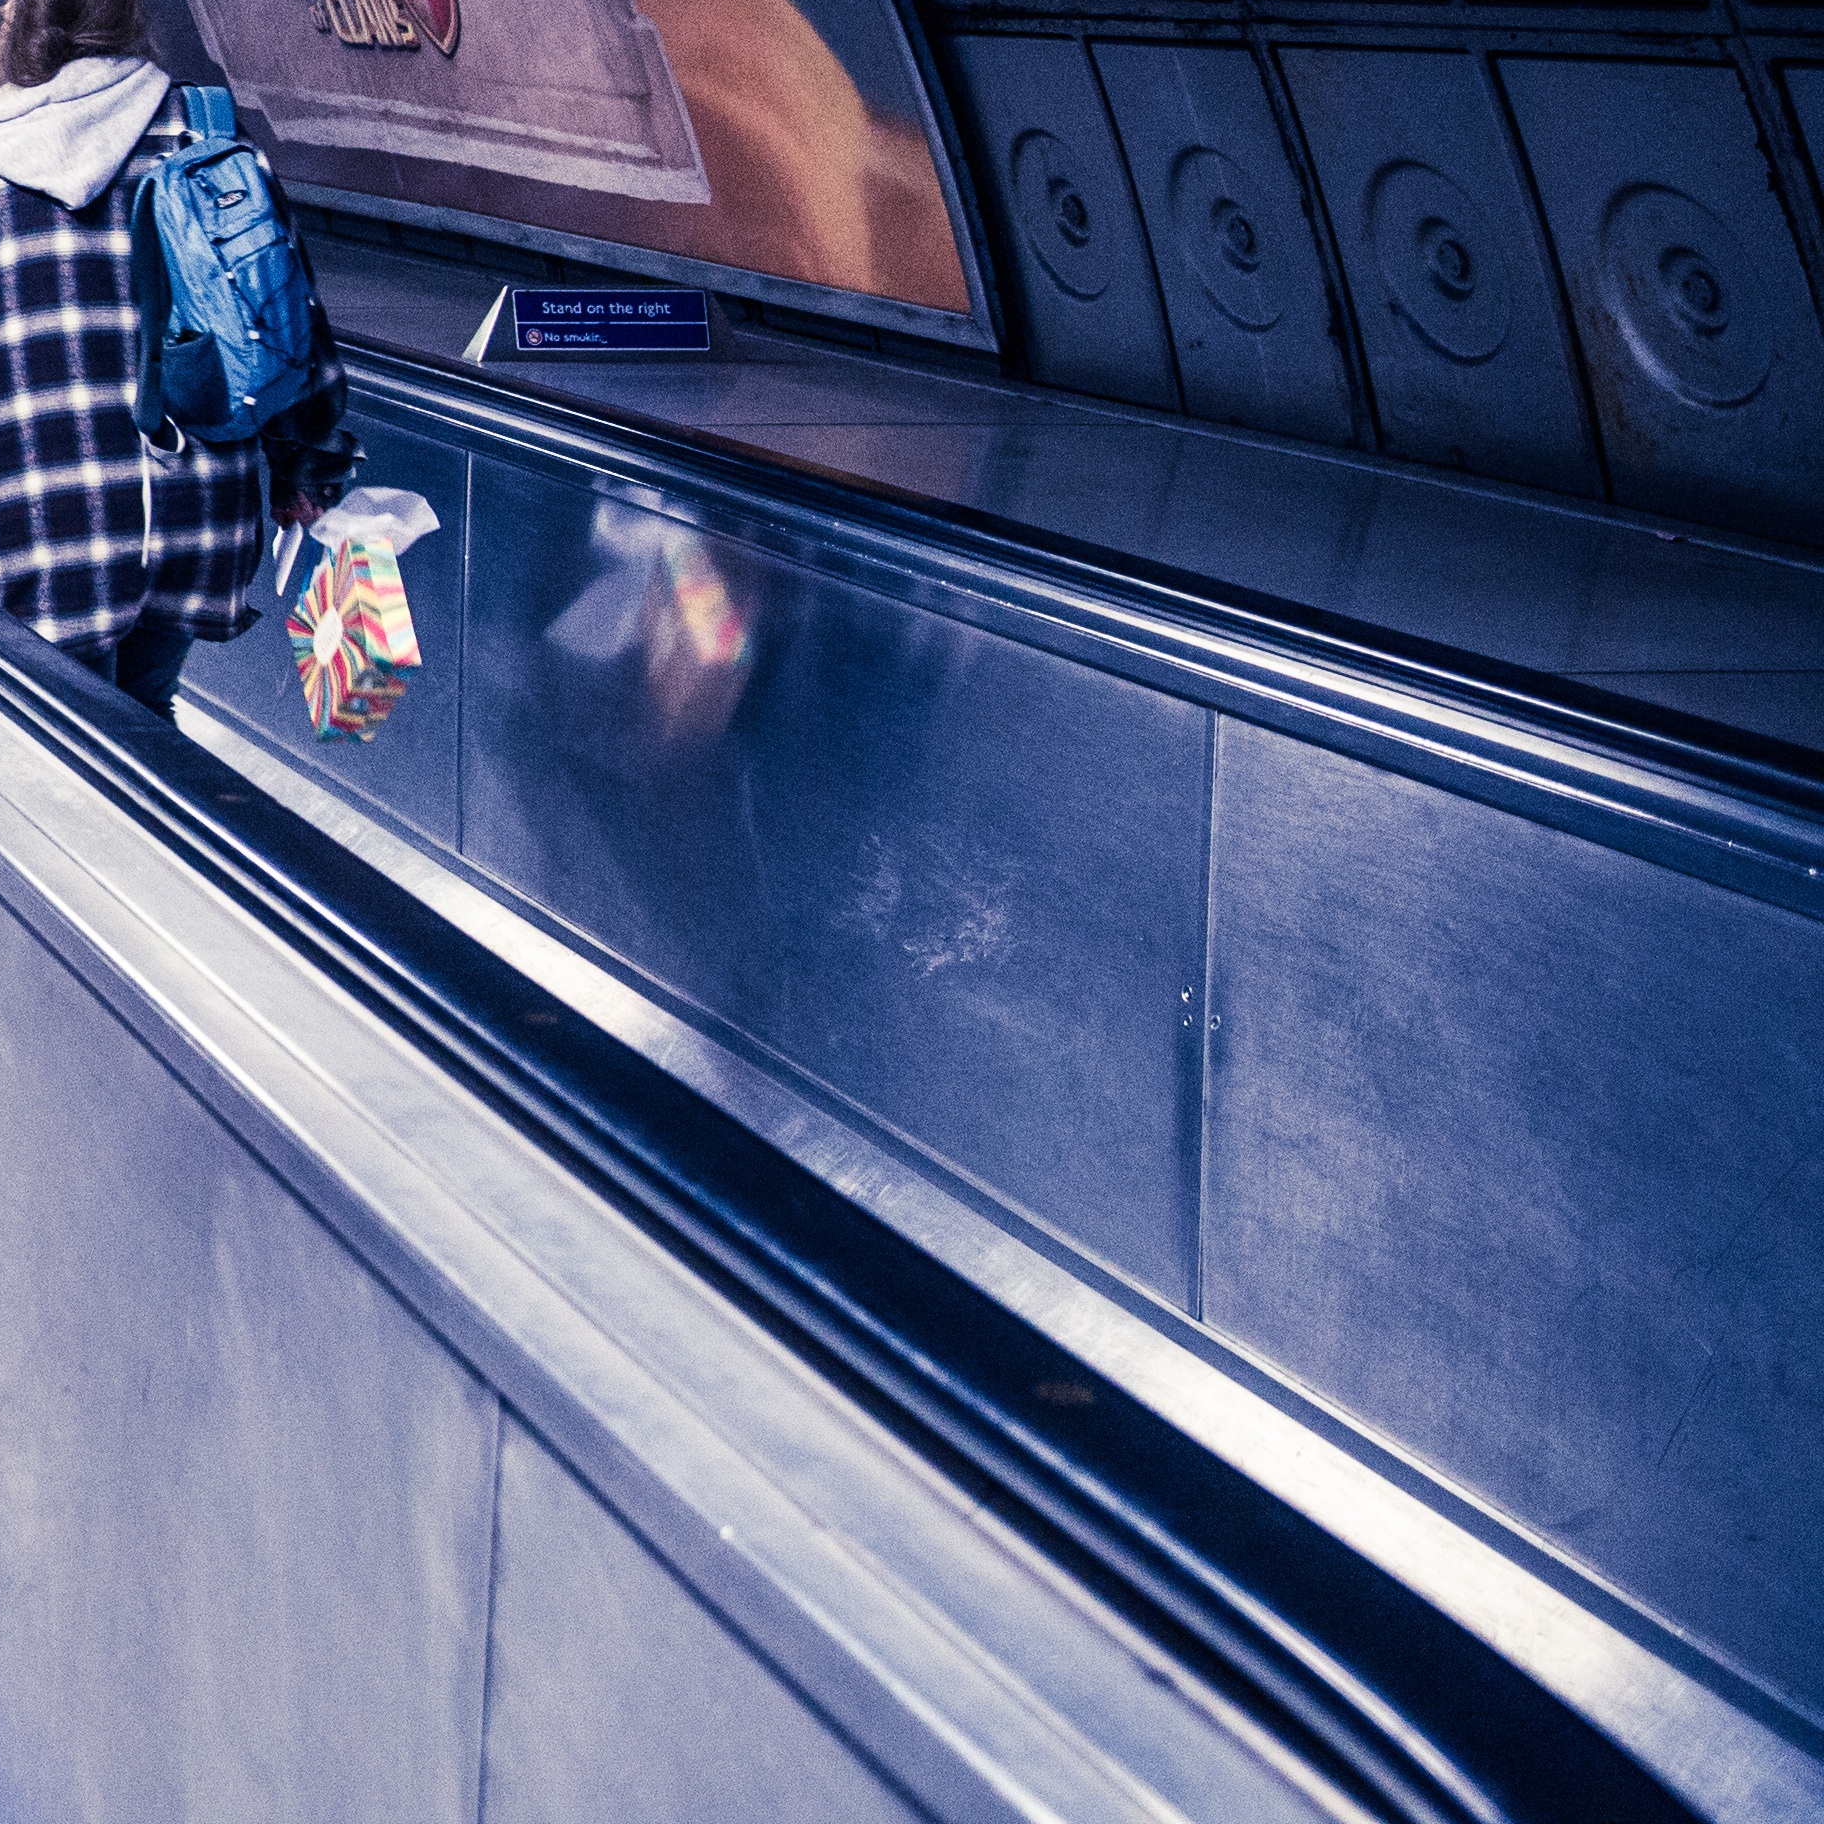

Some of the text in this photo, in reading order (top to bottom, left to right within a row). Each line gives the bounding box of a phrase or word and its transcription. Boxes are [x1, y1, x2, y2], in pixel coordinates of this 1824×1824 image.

[541, 301, 672, 317] Stand on the right
[543, 332, 608, 344] No smokin
